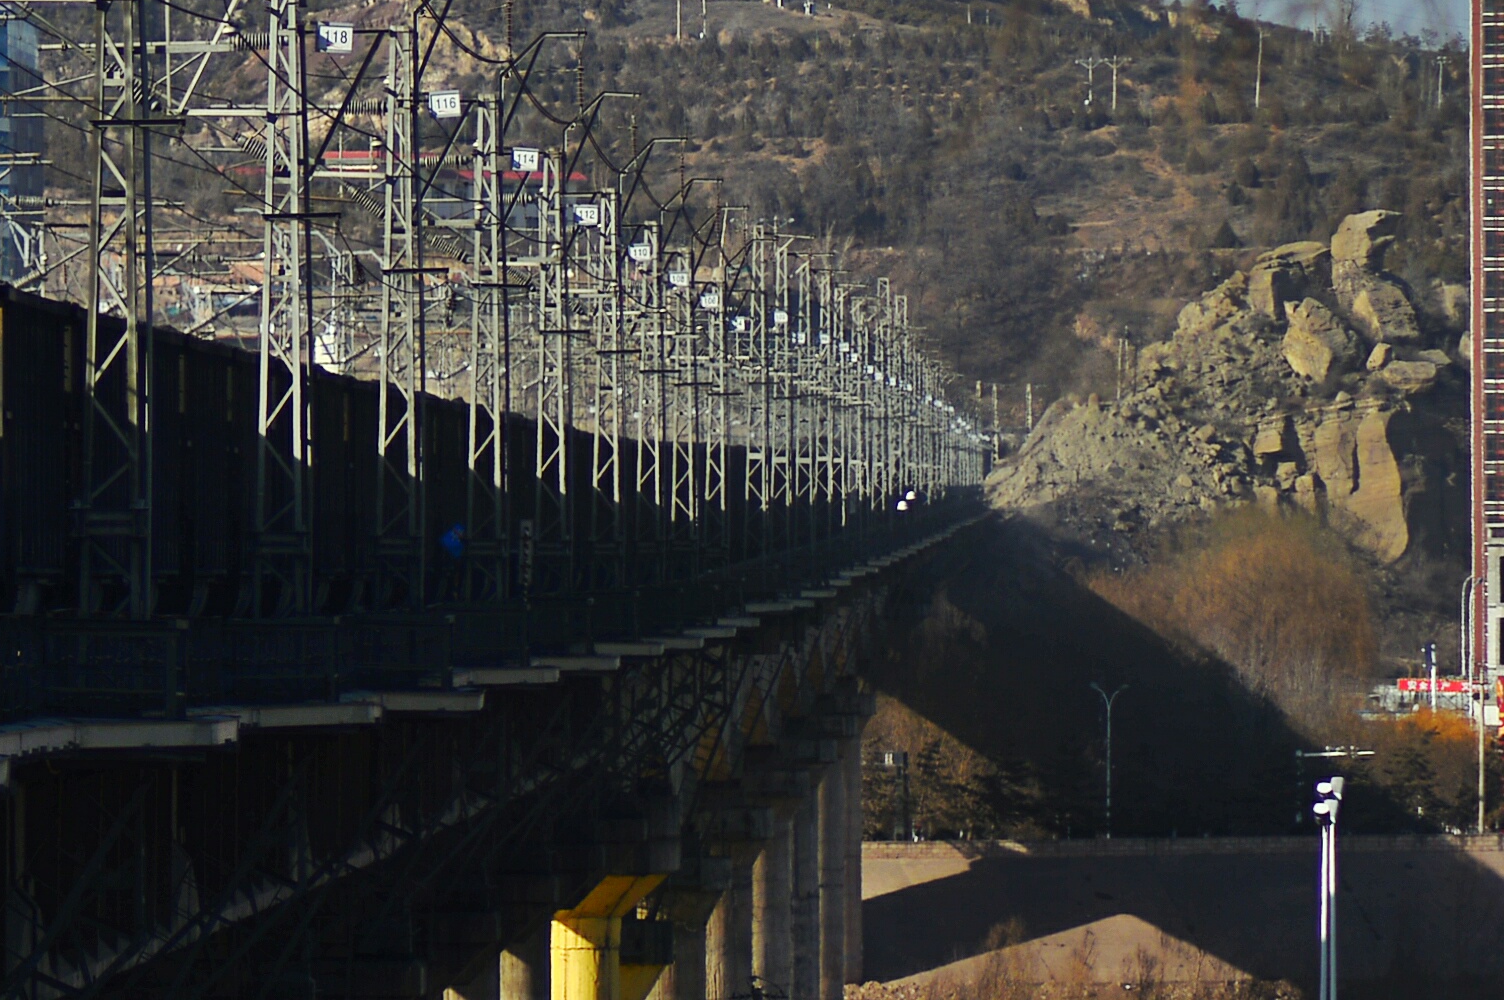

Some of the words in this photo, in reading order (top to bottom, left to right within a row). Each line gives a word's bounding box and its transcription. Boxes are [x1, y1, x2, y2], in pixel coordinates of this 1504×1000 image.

[325, 30, 348, 44] 118
[436, 97, 456, 109] 116
[517, 153, 534, 164] 114
[579, 210, 595, 219] 112
[633, 248, 647, 257] 110
